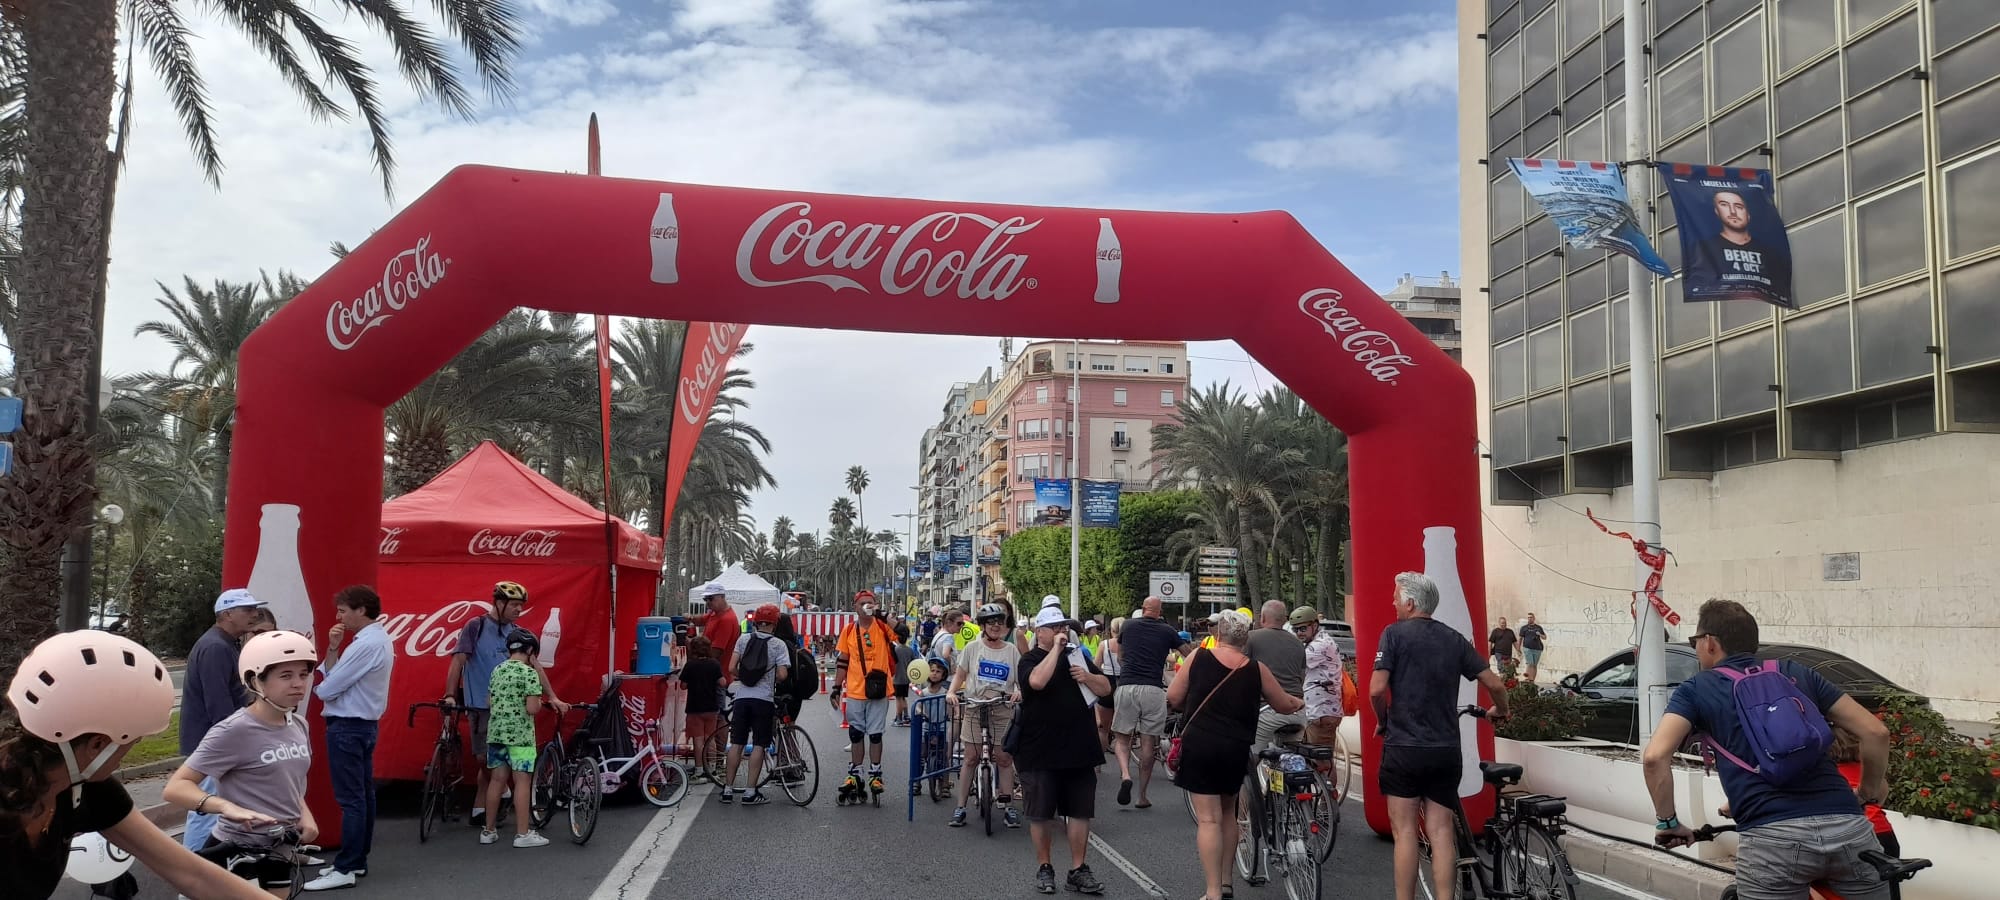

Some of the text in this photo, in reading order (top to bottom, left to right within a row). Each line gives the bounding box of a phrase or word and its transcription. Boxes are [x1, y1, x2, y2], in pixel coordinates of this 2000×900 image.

[735, 201, 1044, 301] Coca-Cola
[1723, 248, 1762, 265] BERET
[1733, 262, 1761, 273] 4 OCT
[326, 231, 447, 351] Coca-Cola
[1298, 287, 1420, 382] Coca-Cola
[468, 528, 560, 558] Coca-Cola
[260, 742, 309, 764] adida
